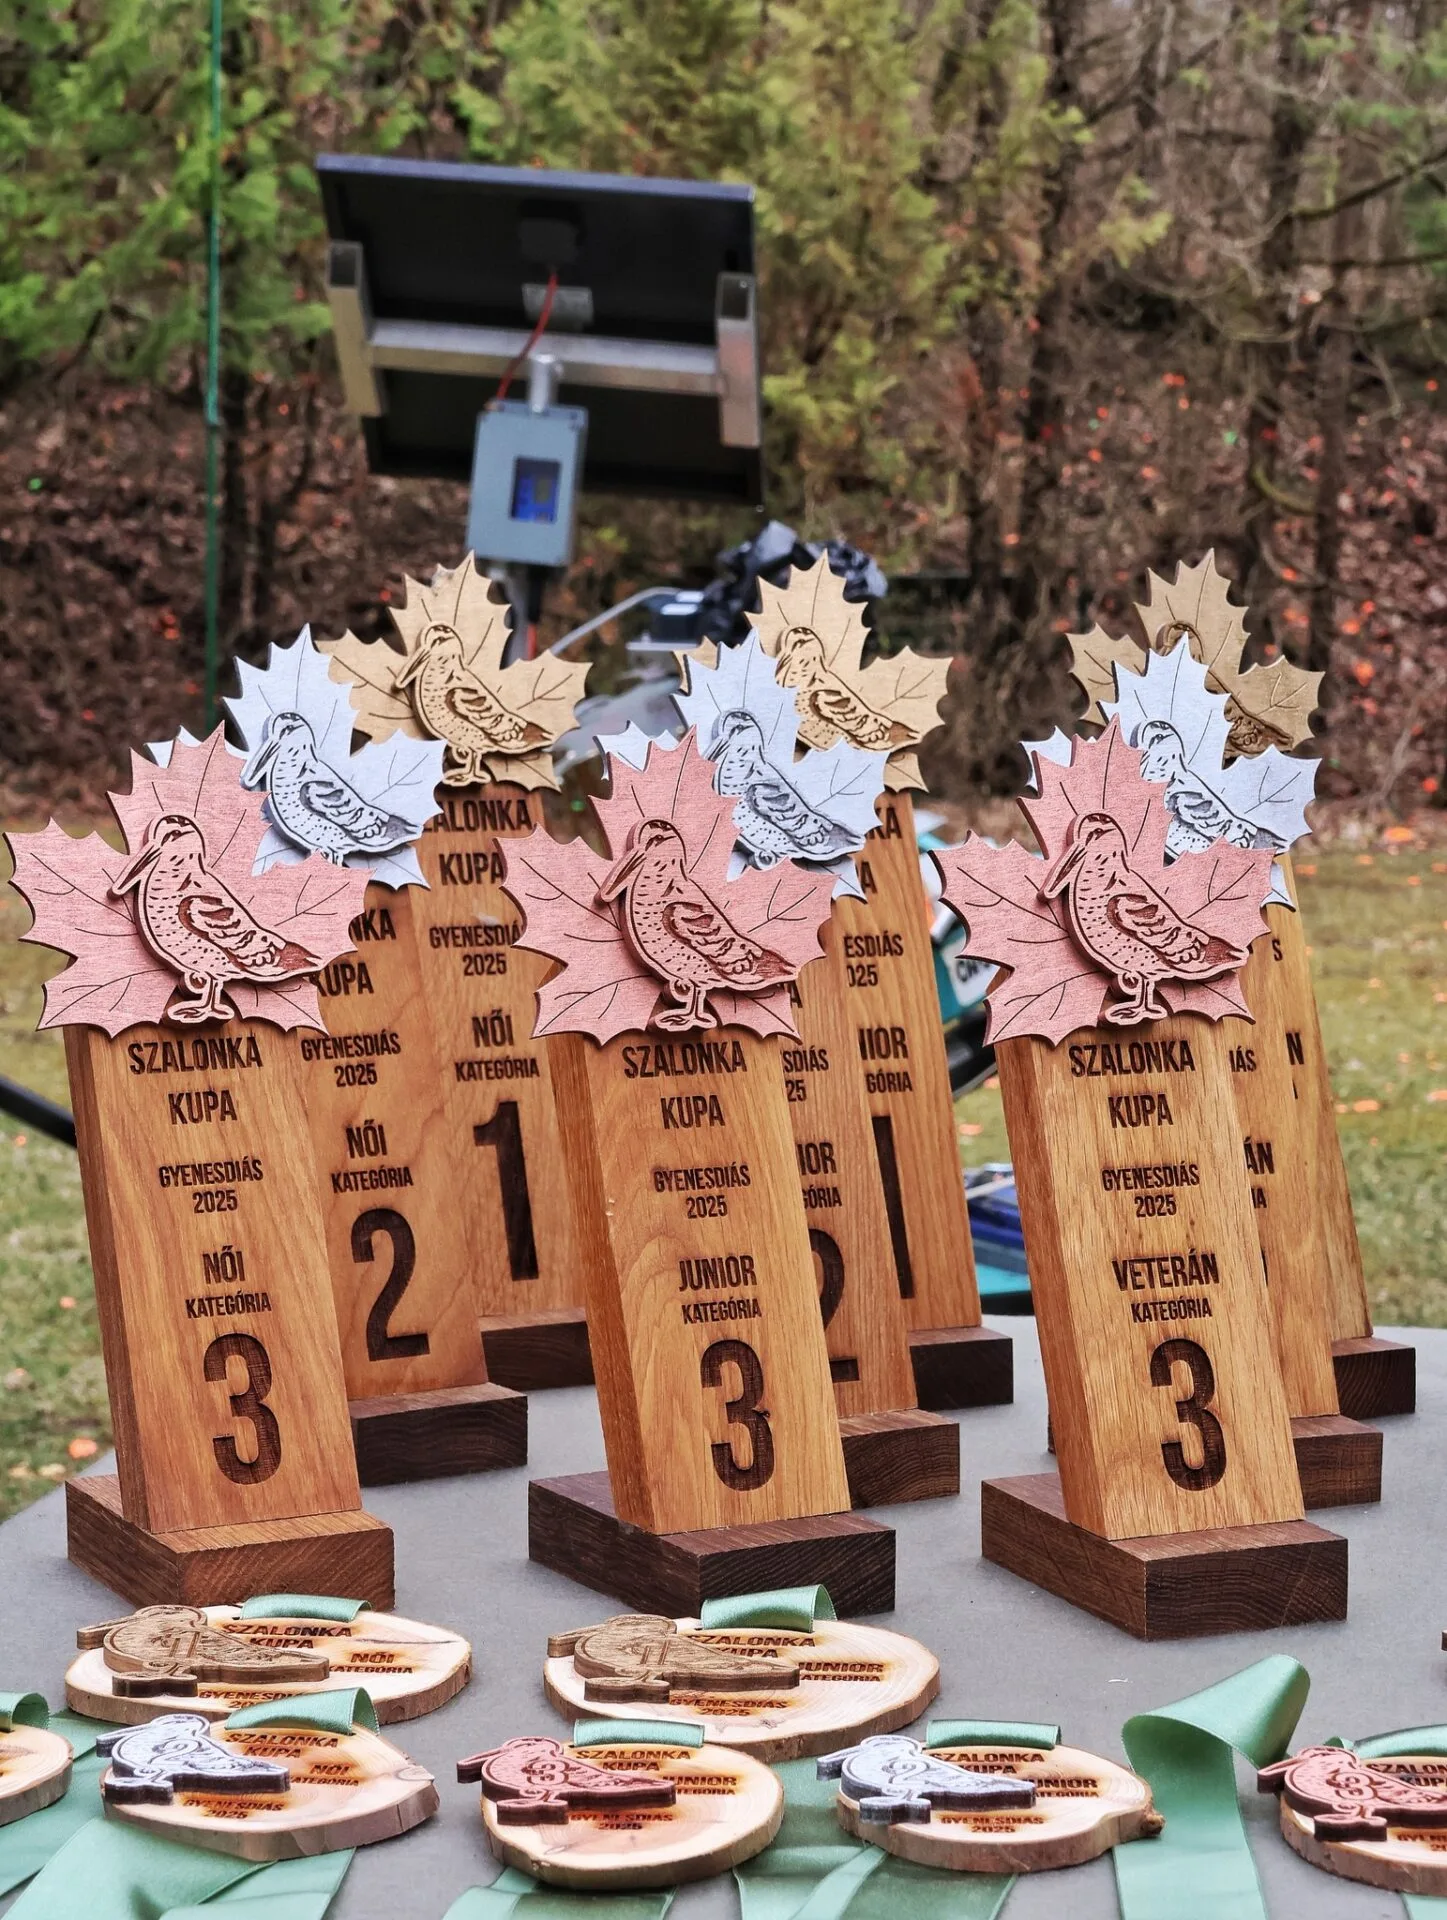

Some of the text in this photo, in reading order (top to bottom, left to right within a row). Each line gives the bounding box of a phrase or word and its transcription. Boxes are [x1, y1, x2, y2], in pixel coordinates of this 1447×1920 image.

[423, 799, 532, 832] ALONKA
[439, 853, 503, 886] KUPA
[429, 921, 524, 949] GYENESDIÁ
[844, 930, 904, 958] ESDIÁS
[462, 954, 507, 976] 2025
[472, 1009, 514, 1048] NŐI
[127, 1036, 263, 1075] SZALONKA
[301, 1028, 401, 1061] GYENESDIÁS
[622, 1040, 747, 1078] SZALONKA
[1068, 1039, 1195, 1077] SZALONKA
[334, 1063, 377, 1087] 2025
[455, 1057, 540, 1082] KATEGÓRIA
[866, 1069, 913, 1093] GÓRIA
[168, 1089, 237, 1125] KUPA
[660, 1094, 725, 1130] KUPA
[1108, 1093, 1173, 1128] KUPA
[345, 1119, 387, 1158] NŐI
[158, 1156, 264, 1188] GYENESDIÁS
[331, 1165, 413, 1193] KATEGÓRIA
[653, 1161, 750, 1193] GYENESDIÁS
[1101, 1160, 1200, 1191] GYENESDIÁS
[192, 1189, 238, 1214] 2025
[473, 1101, 539, 1281] 1
[685, 1194, 728, 1219] 2025
[1134, 1194, 1177, 1218] 2025
[202, 1245, 245, 1284] NŐI
[679, 1255, 757, 1292] JUNIOR
[1111, 1248, 1220, 1292] VETERÁN
[351, 1207, 430, 1361] 2
[185, 1291, 272, 1319] KATEGÓRIA
[682, 1296, 762, 1324] KATEGÓRIA
[1131, 1295, 1212, 1324] KATEGÓRIA
[203, 1332, 282, 1485] 3
[701, 1339, 775, 1491] 3
[1150, 1338, 1227, 1491] 3
[222, 1624, 353, 1637] SZALONKA
[249, 1637, 315, 1649] KUPA
[225, 1733, 339, 1748] SZALONKA
[243, 1746, 301, 1759] KUPA
[576, 1750, 691, 1760] SZALONKA
[602, 1761, 660, 1771] KUPA
[1366, 1763, 1447, 1774] SZALON
